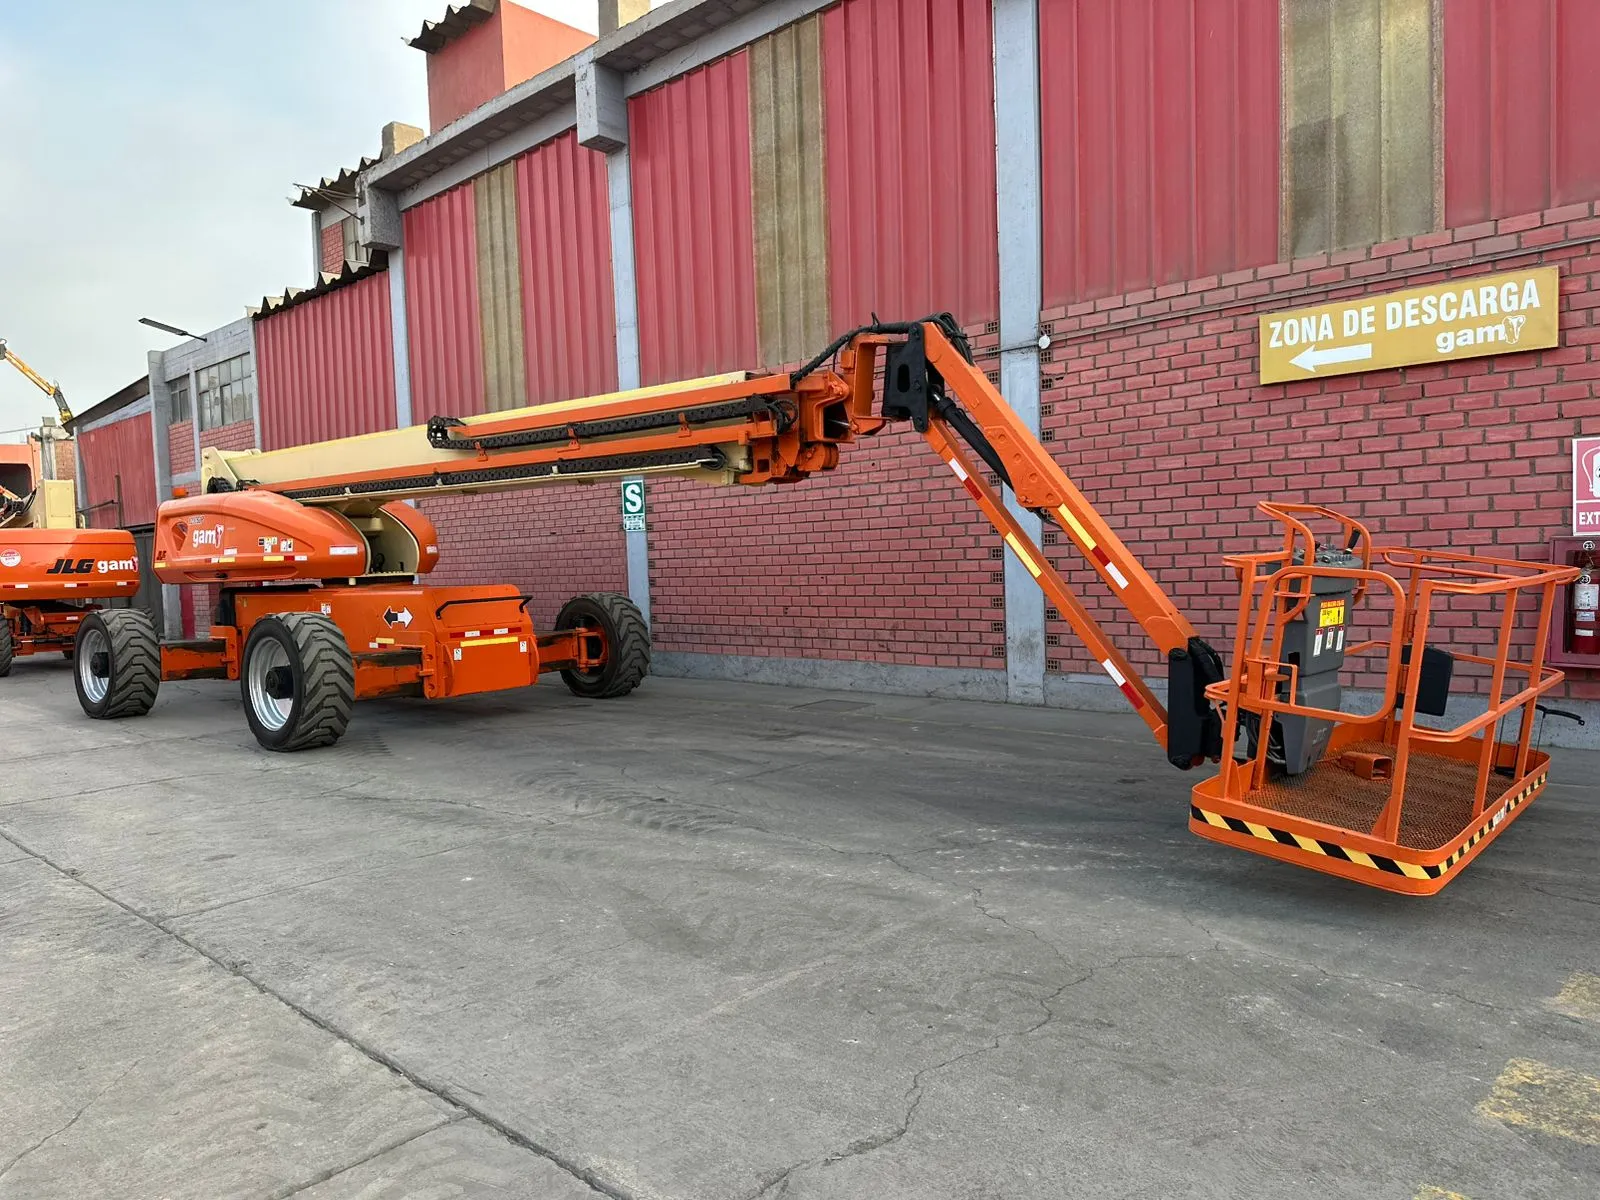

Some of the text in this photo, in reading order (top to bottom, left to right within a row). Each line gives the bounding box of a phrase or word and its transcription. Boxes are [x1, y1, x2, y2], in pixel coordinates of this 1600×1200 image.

[1269, 279, 1540, 348] ZONA DE DESCARGA
[1436, 322, 1506, 354] gam
[625, 484, 642, 512] S
[192, 529, 217, 548] gam
[46, 558, 134, 574] JLG gam
